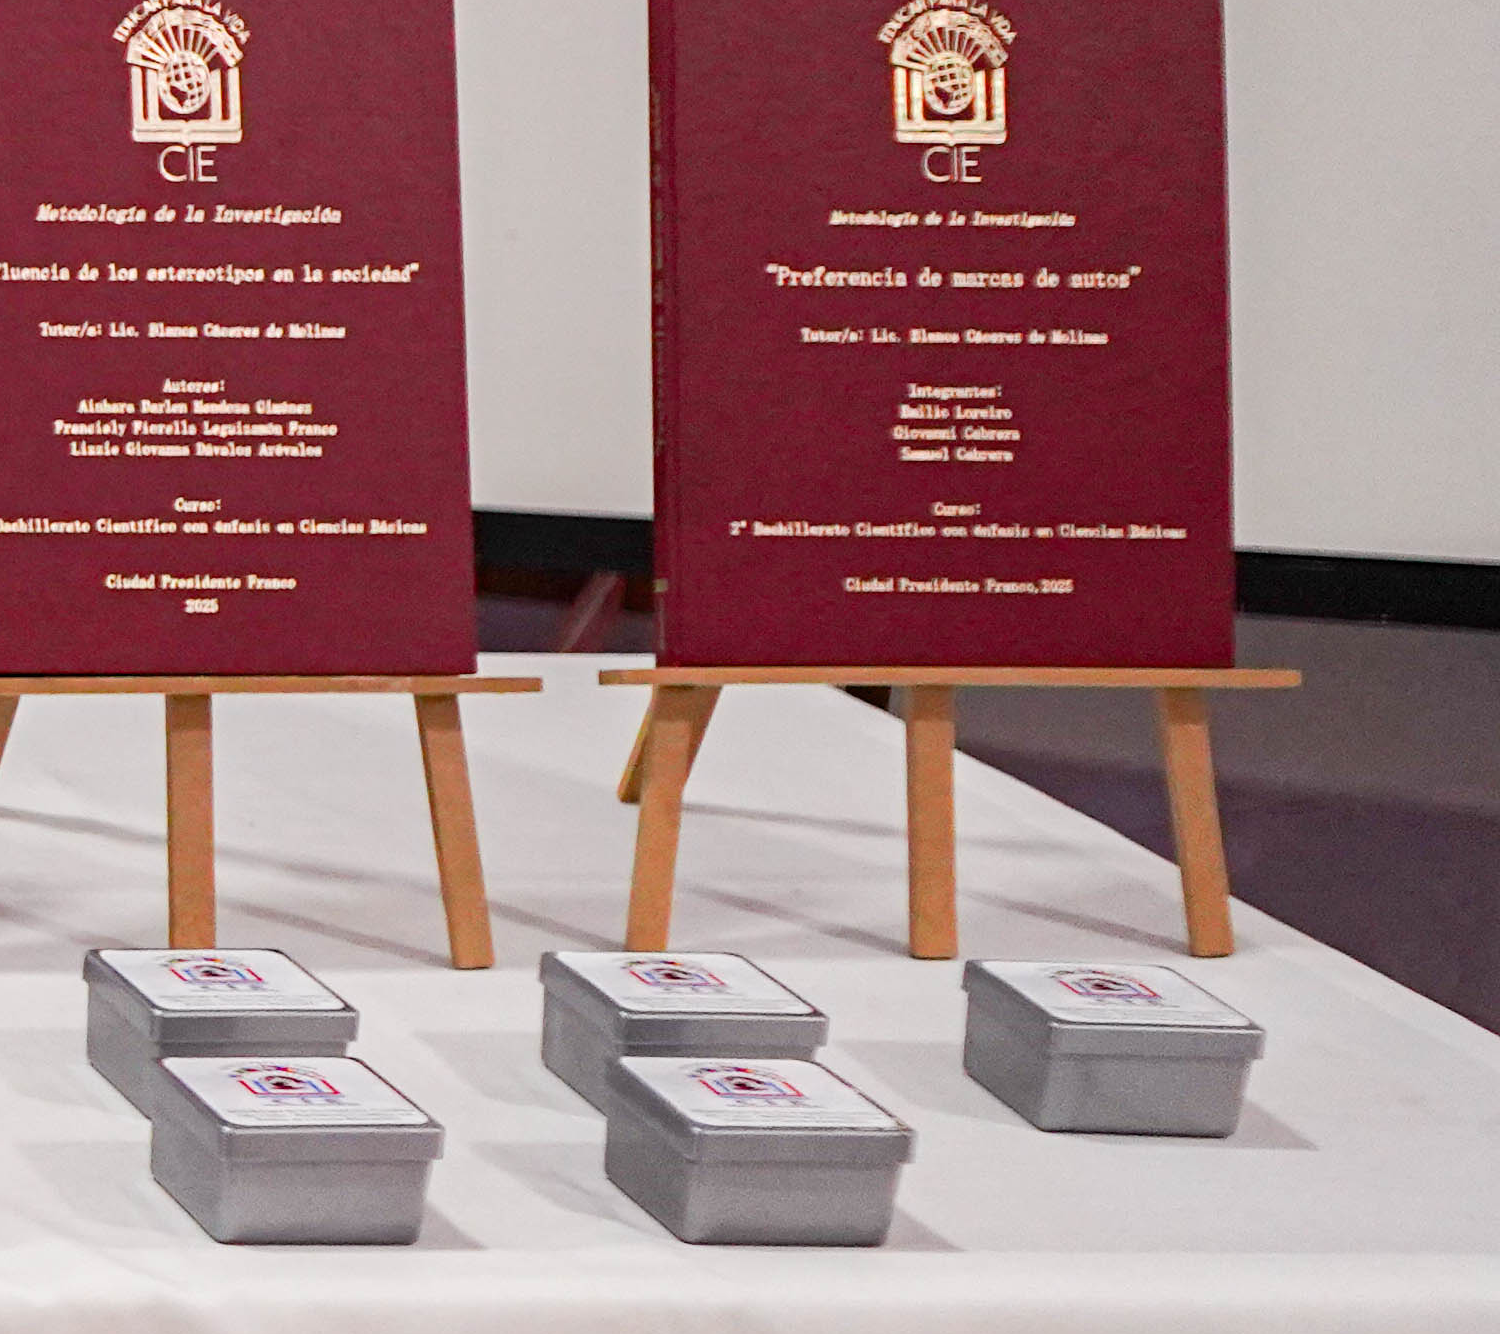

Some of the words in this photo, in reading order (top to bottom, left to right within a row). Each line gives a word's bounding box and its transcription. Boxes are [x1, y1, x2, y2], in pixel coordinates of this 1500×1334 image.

[157, 144, 218, 182] CIE
[921, 146, 982, 182] CIE
[153, 205, 177, 222] de
[183, 204, 206, 222] la
[77, 263, 100, 281] de
[107, 263, 138, 281] los
[272, 269, 295, 282] en
[302, 264, 324, 282] la
[916, 267, 943, 287] de
[1033, 268, 1060, 288] de
[104, 574, 156, 589] Ciudad
